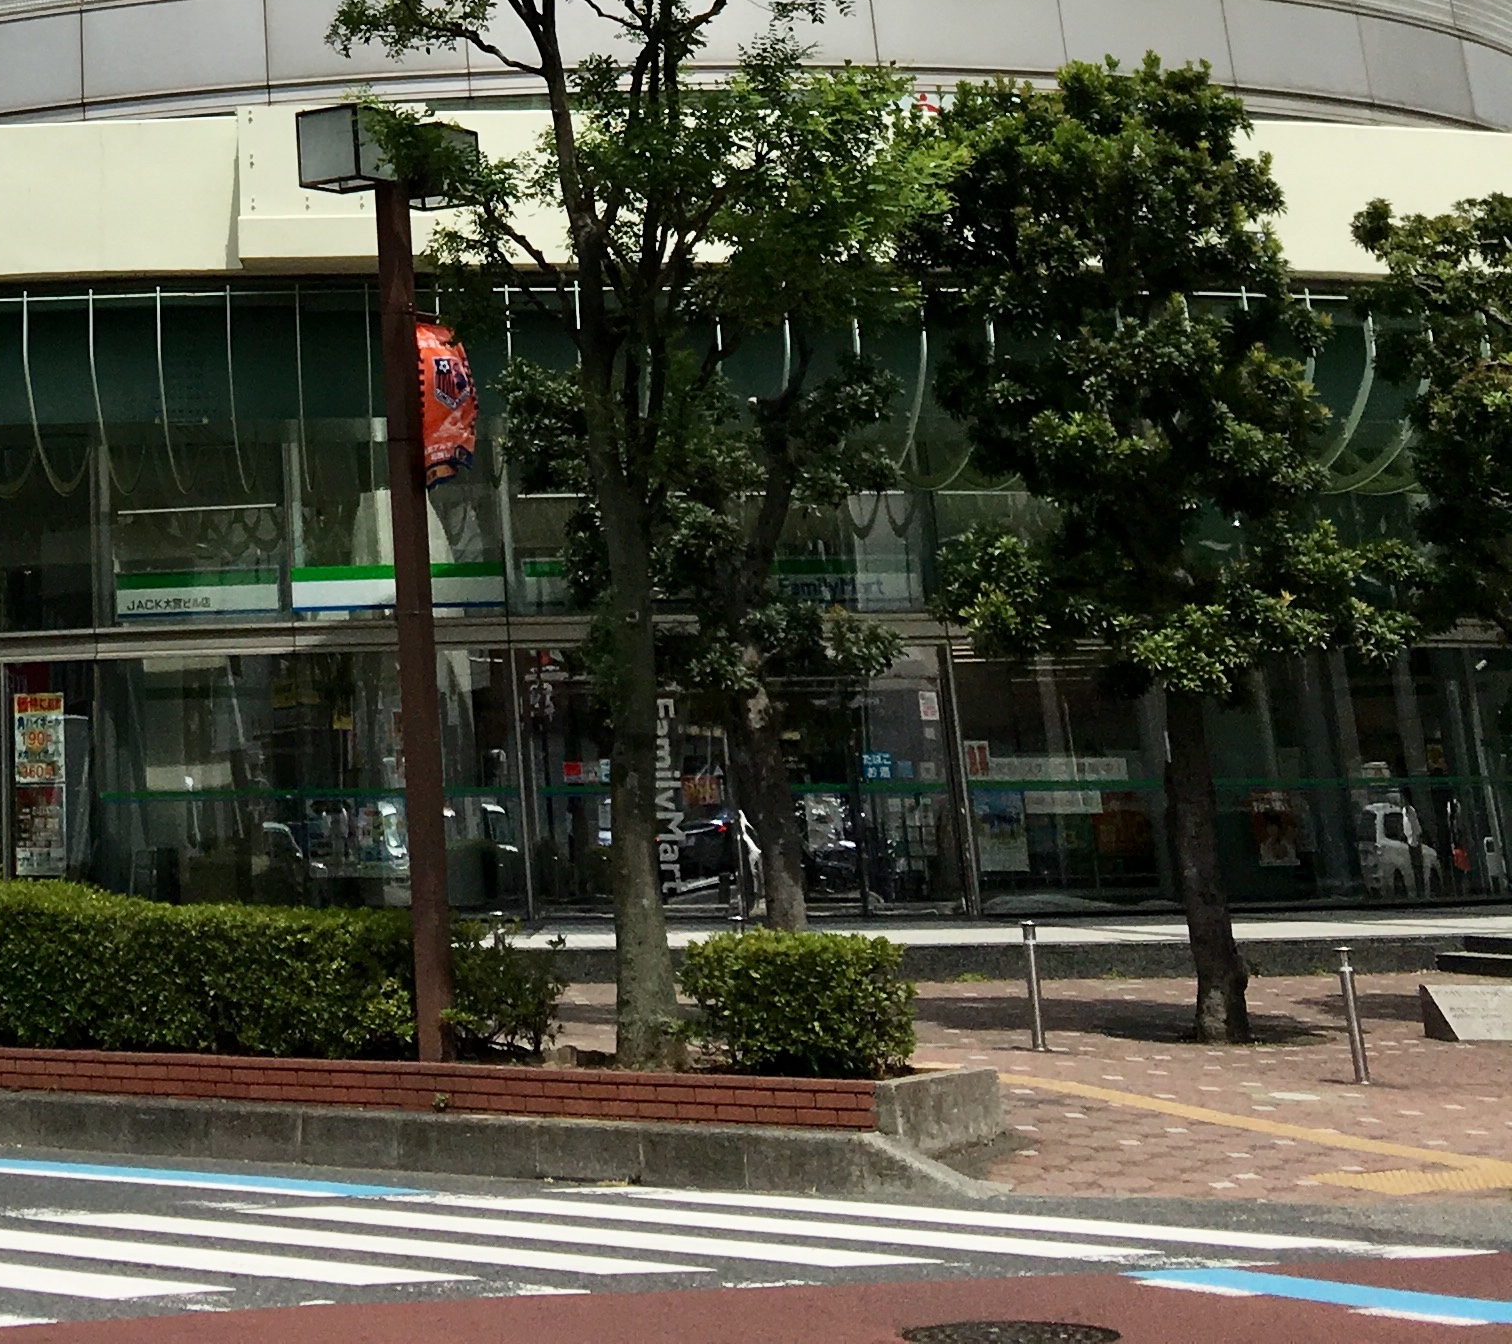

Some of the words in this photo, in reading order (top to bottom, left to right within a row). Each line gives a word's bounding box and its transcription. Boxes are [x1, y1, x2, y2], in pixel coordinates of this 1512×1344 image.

[126, 596, 211, 611] JACK大宮ビル店
[655, 698, 686, 894] FamilyMart
